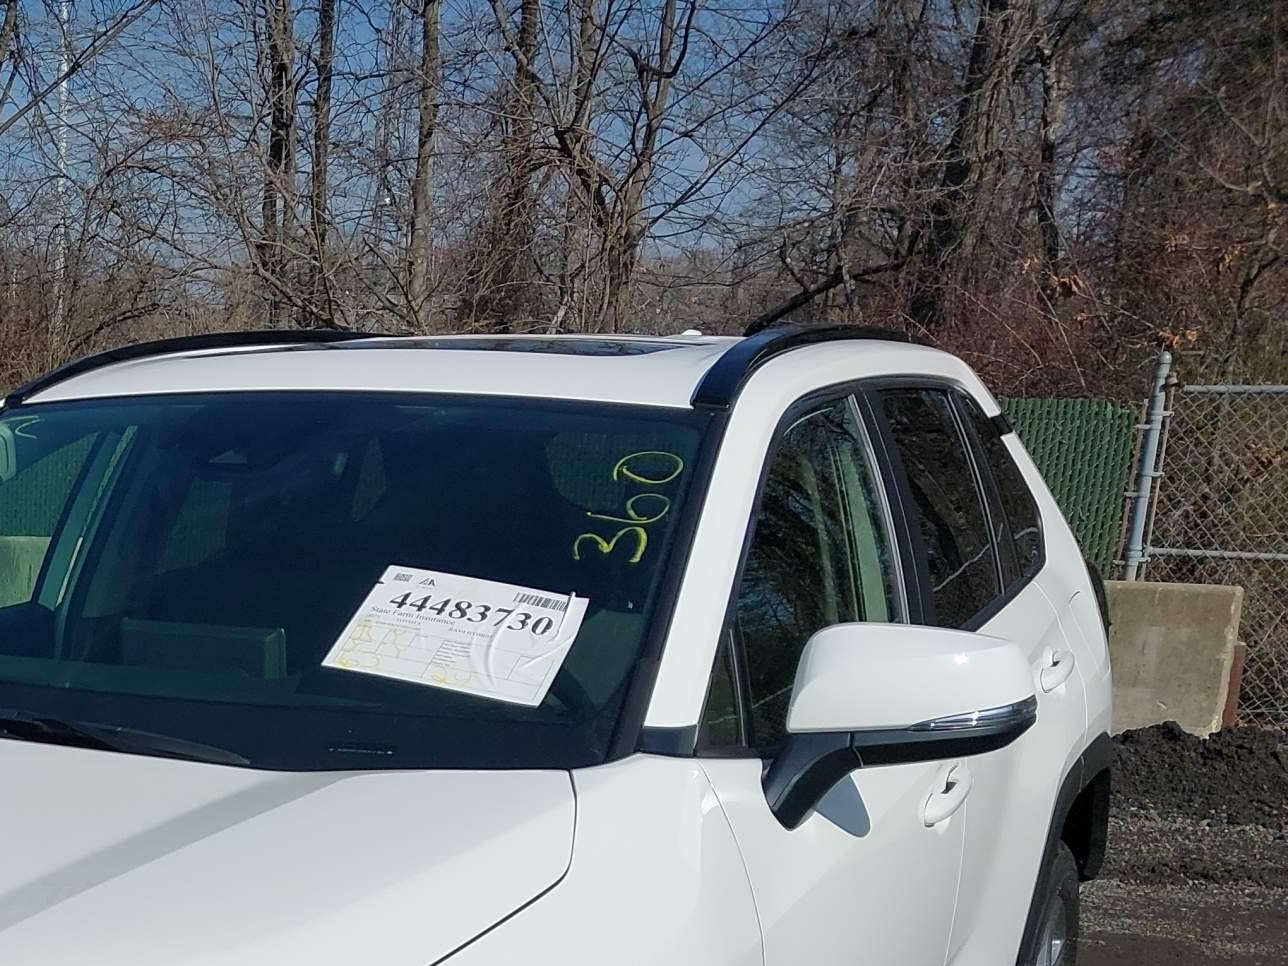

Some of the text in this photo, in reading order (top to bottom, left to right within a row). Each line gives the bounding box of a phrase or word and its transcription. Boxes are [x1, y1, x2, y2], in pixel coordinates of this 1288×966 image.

[573, 450, 685, 563] 360
[389, 591, 554, 637] 44483730
[393, 609, 414, 618] Farm
